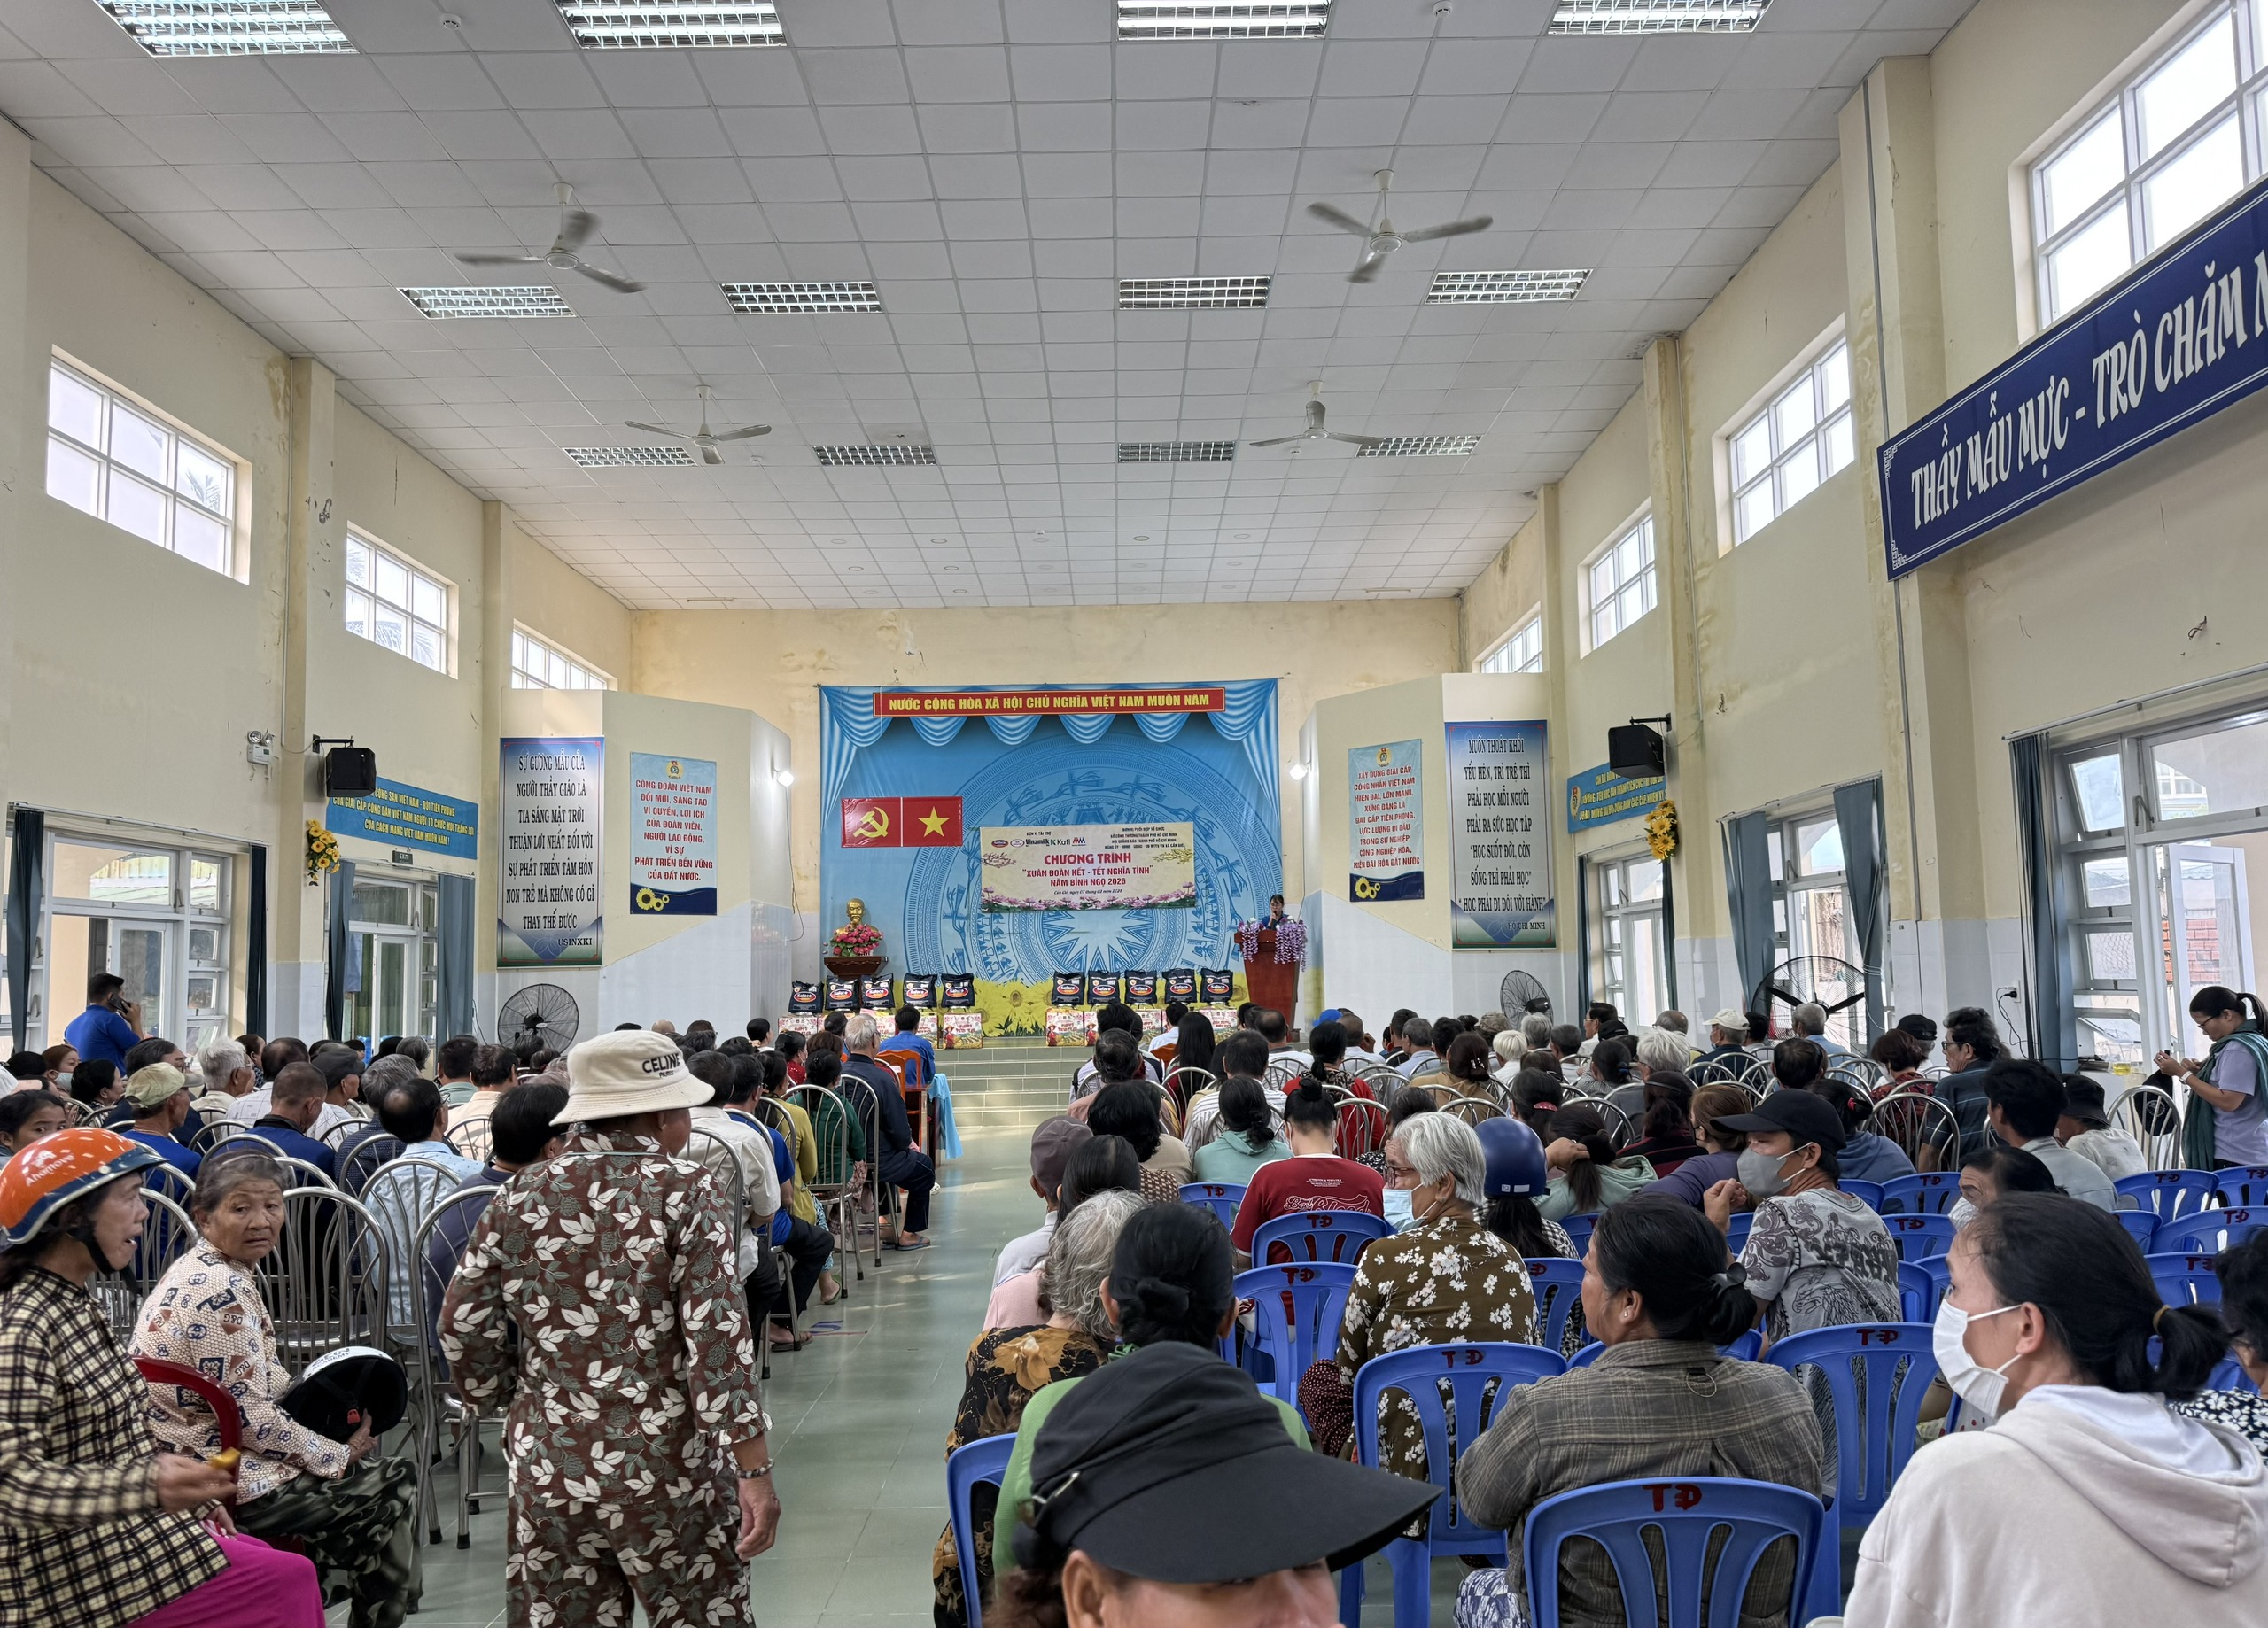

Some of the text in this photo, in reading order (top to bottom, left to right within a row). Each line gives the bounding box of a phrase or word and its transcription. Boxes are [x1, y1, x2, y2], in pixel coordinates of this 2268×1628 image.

[1911, 423, 1961, 530] THẦY
[1966, 391, 2012, 501] MẪU
[2018, 375, 2070, 479] MỰC
[2092, 309, 2147, 429] TRÒ
[2154, 260, 2248, 393] CHĂM
[889, 693, 1209, 712] NƯỚC CỘNG HÒA XÃ HỘI CHỦ NGHĨA VIỆT NAM MUÔN NĂM
[1494, 762, 1504, 779] TRÌ
[1519, 761, 1531, 779] THÌ
[517, 775, 586, 797] NGƯỜI THẦY GIÁO LÀ
[695, 786, 712, 795] NAM
[1467, 787, 1481, 807] PHẢI
[1483, 792, 1496, 810] HỌC
[1511, 788, 1529, 806] NGƯỜI
[518, 809, 530, 823] TIA
[532, 805, 549, 823] SÁNG
[568, 805, 585, 823] TRỜI
[1466, 813, 1481, 833] PHẢI
[1482, 818, 1491, 833] RA
[1506, 818, 1518, 835] HỌC
[547, 828, 566, 849] NHẤT
[567, 828, 579, 849] ĐỐI
[581, 831, 594, 849] VỚI
[668, 833, 681, 842] LAO
[1487, 838, 1503, 858] SUỐT
[1518, 841, 1531, 858] CÒN
[509, 853, 593, 880] SỰ PHÁT TRIỂN TÂM HỒN
[1044, 852, 1131, 865] CHƯƠNG TRÌNH
[1049, 867, 1069, 877] ĐOÀN
[1072, 865, 1085, 876] KẾT
[1092, 865, 1105, 876] TẾT
[1107, 865, 1130, 875] NGHĨA
[1471, 864, 1487, 885] SỐNG
[1488, 867, 1499, 885] THÌ
[1501, 865, 1515, 885] PHẢI
[506, 883, 594, 903] NON TRẺ MÀ KHÔNG CÓ GÌ
[1070, 878, 1088, 887] BÍNH
[1090, 878, 1106, 888] NGỌ
[1478, 892, 1492, 911] PHẢI
[1493, 897, 1500, 911] ĐI
[1502, 894, 1513, 911] ĐÔI
[1514, 894, 1525, 911] VỚI
[523, 908, 578, 932] THAY THẾ ĐƯỢC
[557, 937, 593, 946] USINXKI
[642, 1053, 680, 1074] CELINE
